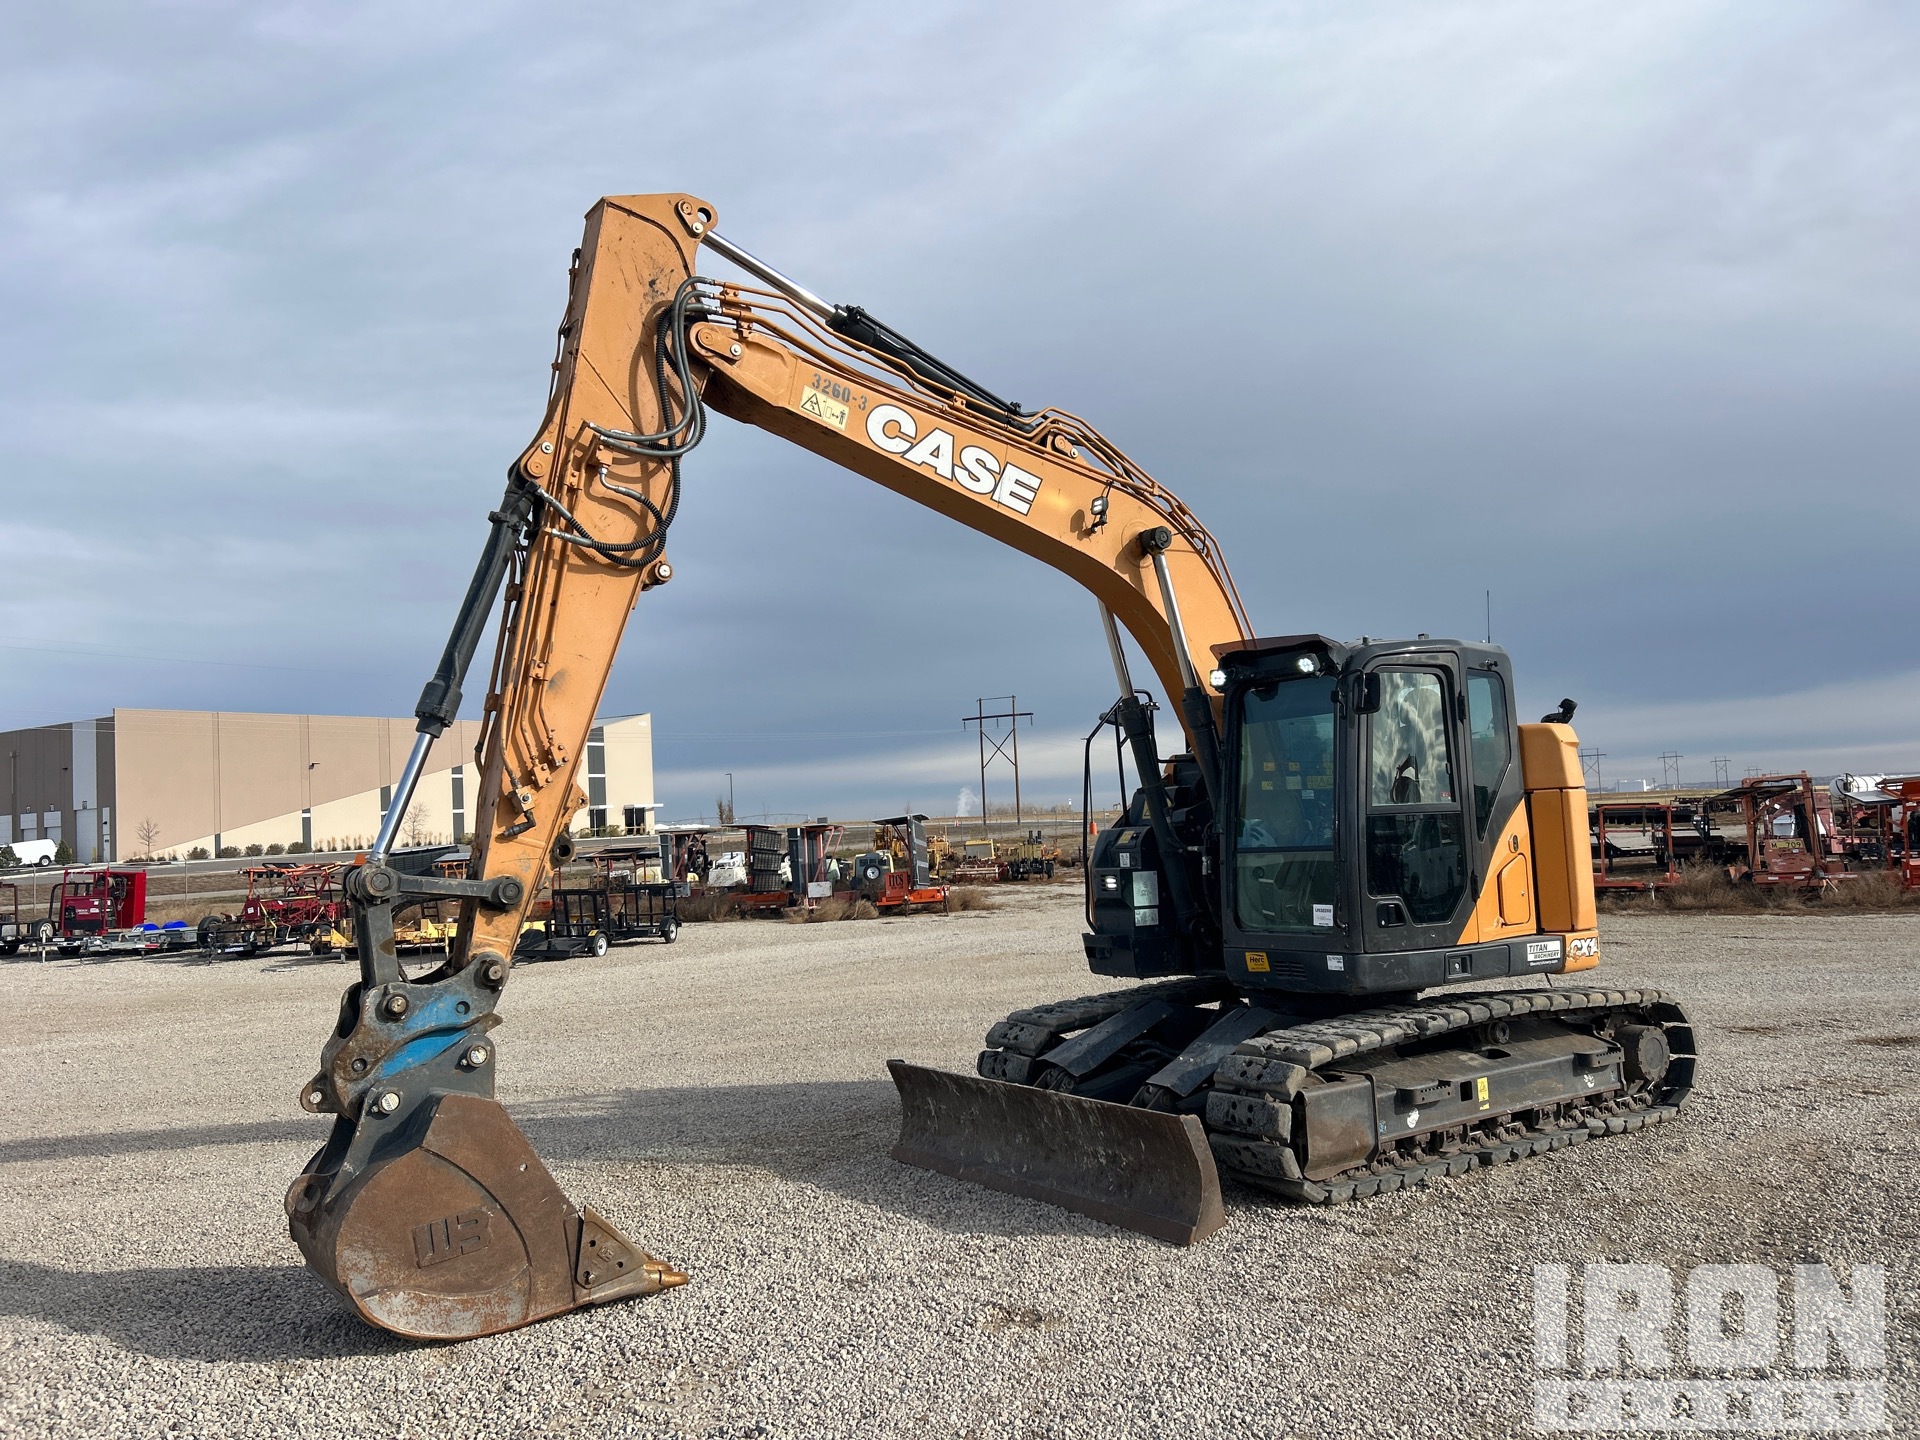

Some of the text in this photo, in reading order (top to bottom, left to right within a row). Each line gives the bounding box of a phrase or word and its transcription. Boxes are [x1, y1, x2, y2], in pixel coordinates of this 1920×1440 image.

[811, 373, 868, 411] 3260-3
[866, 403, 1043, 516] CASE
[1528, 944, 1548, 953] TITAN
[1533, 951, 1560, 959] MACHINERY
